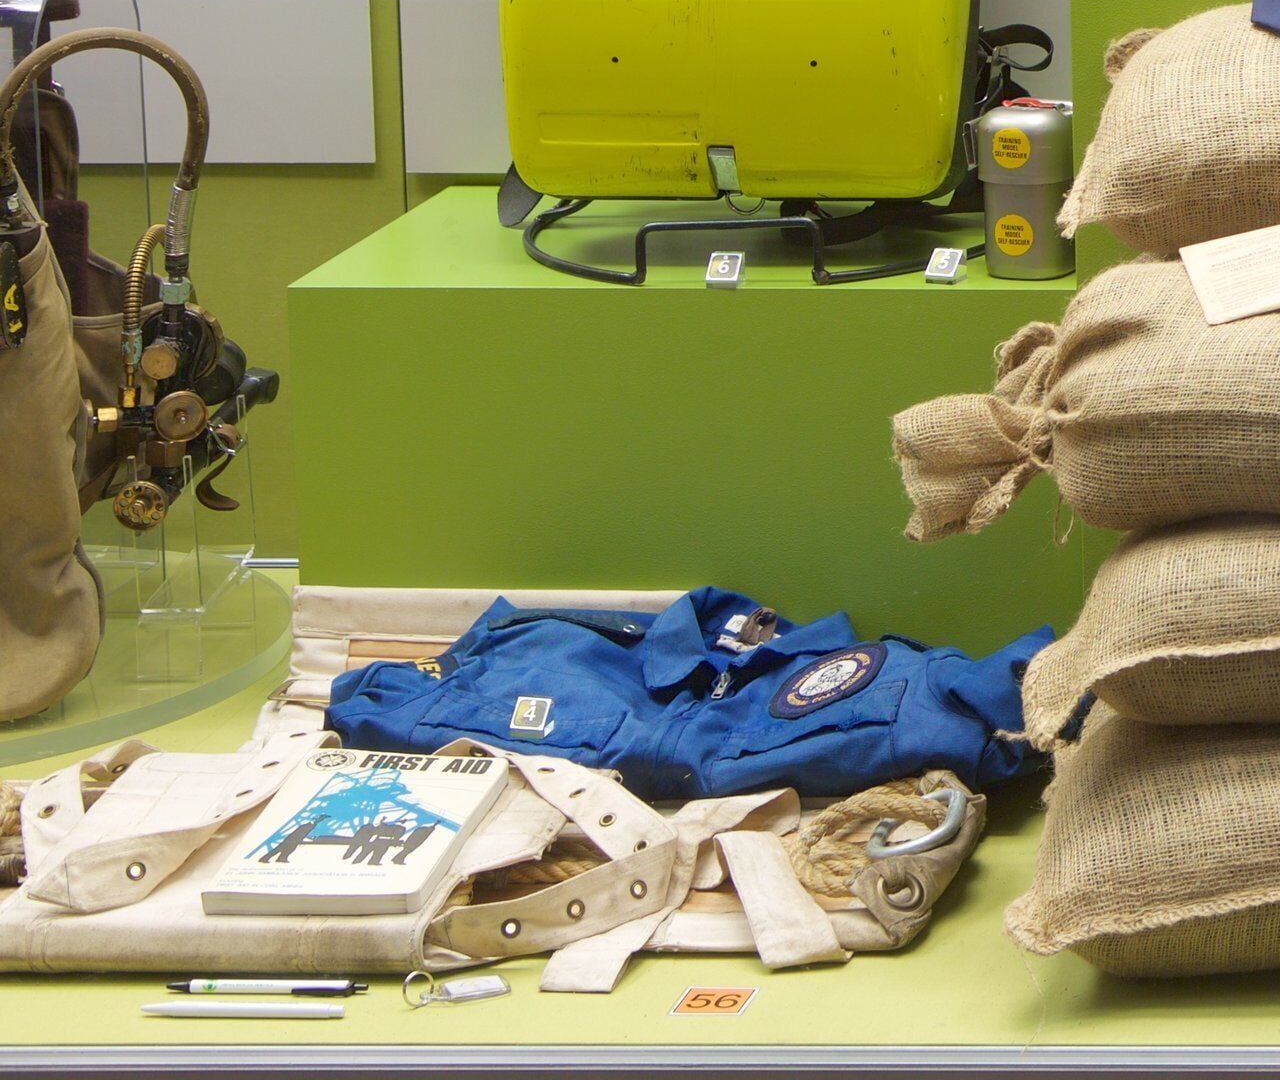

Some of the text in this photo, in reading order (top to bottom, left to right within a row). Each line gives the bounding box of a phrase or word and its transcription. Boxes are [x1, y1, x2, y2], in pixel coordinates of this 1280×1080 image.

[718, 259, 729, 273] 6
[938, 255, 950, 269] 5
[523, 706, 536, 721] 4
[359, 754, 440, 773] FIRST
[442, 758, 493, 775] AID
[686, 993, 742, 1009] 56
